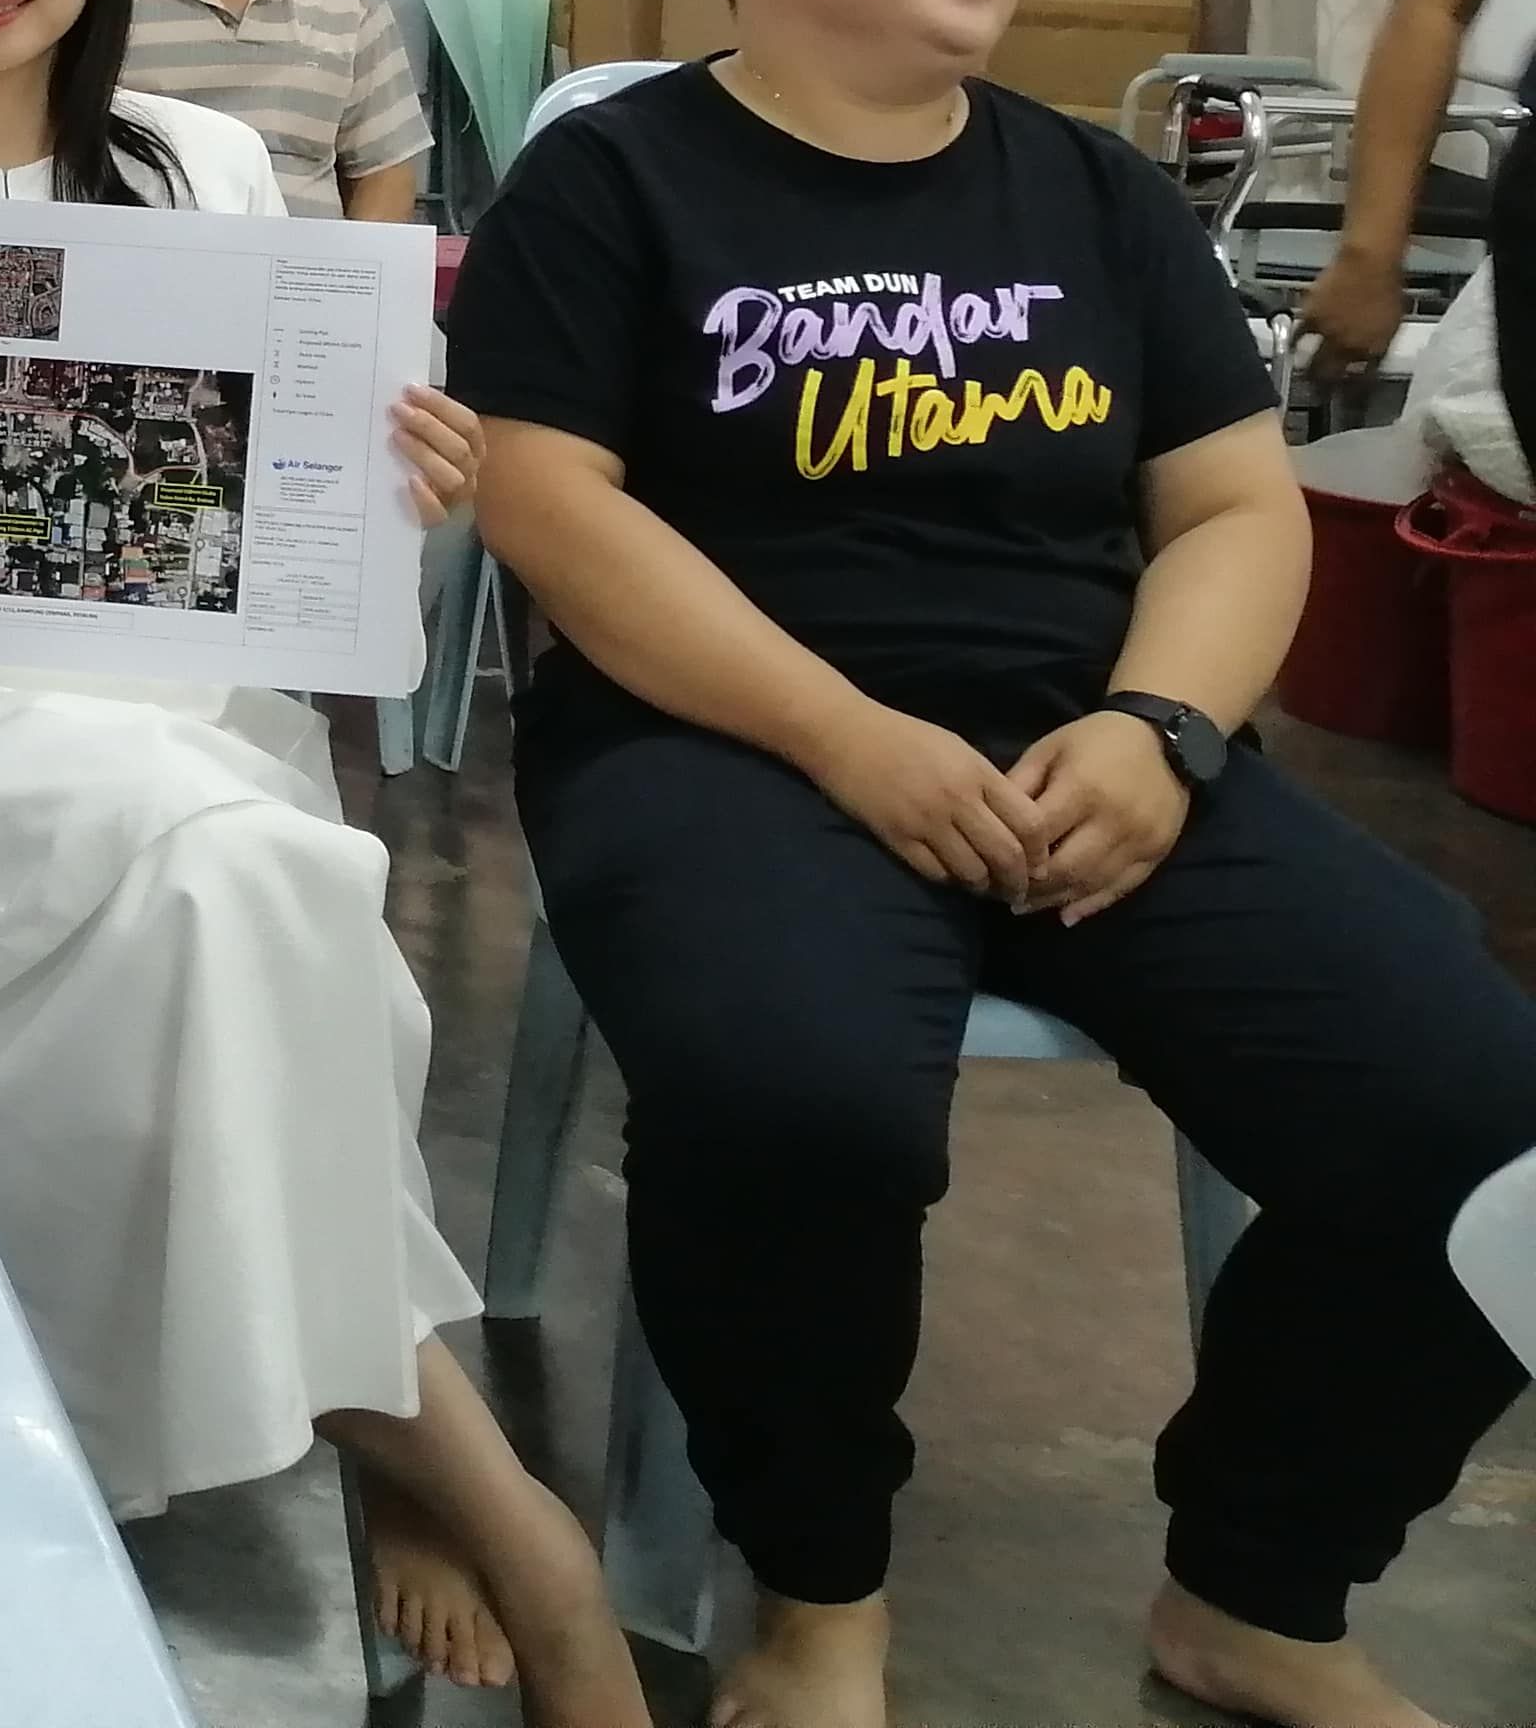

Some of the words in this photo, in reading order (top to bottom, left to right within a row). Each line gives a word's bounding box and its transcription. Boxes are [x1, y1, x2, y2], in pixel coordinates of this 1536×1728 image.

[703, 272, 1064, 413] Bandar
[778, 276, 861, 302] TEAM
[863, 273, 919, 294] DUN
[795, 357, 1112, 481] Utama
